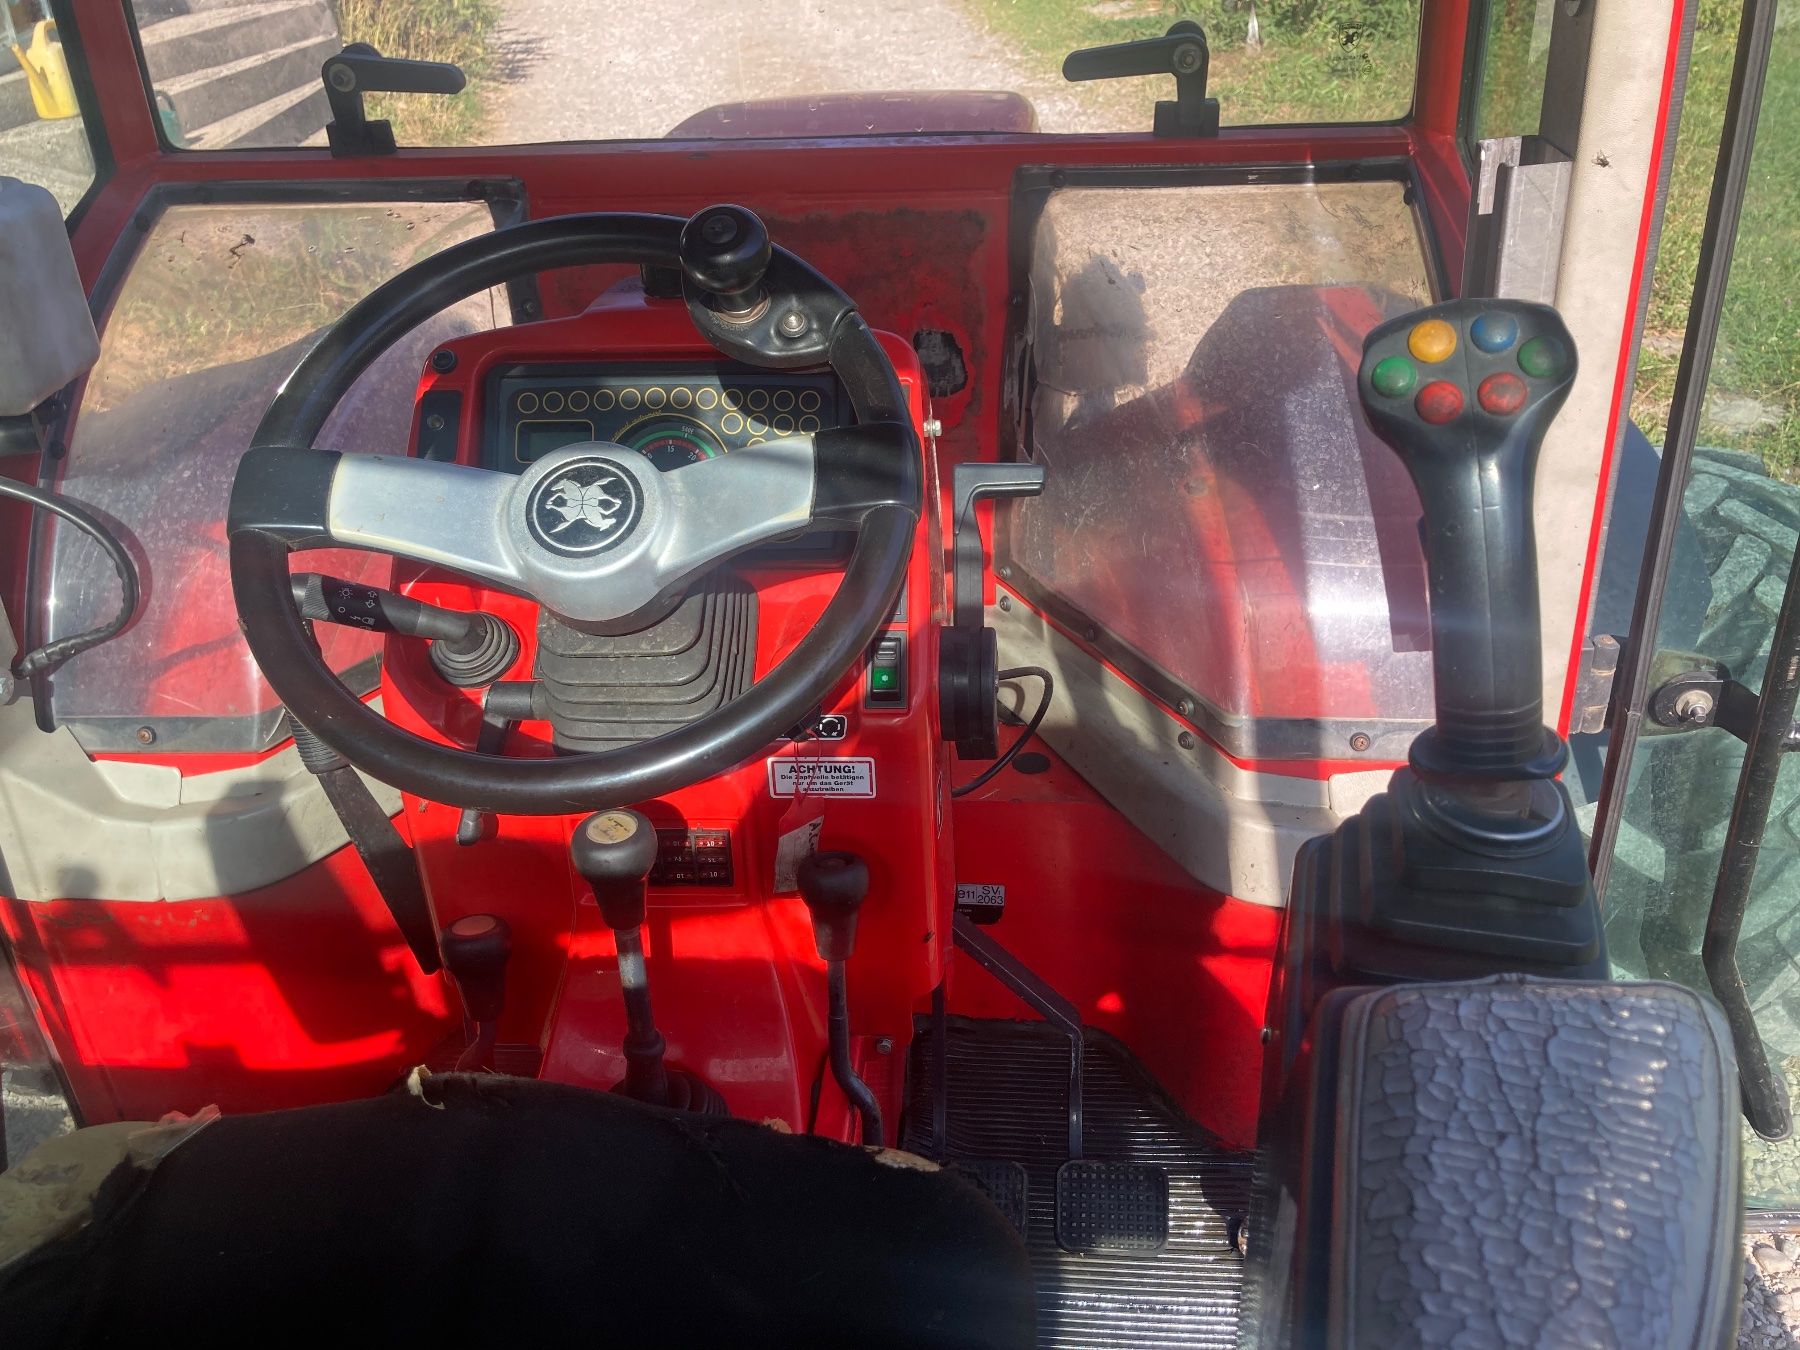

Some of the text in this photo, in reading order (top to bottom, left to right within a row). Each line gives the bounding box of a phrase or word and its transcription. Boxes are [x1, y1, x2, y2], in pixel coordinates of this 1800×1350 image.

[667, 445, 675, 453] 15
[688, 452, 697, 461] 20
[789, 765, 855, 773] ACHTUNG!
[977, 895, 1003, 904] 2063
